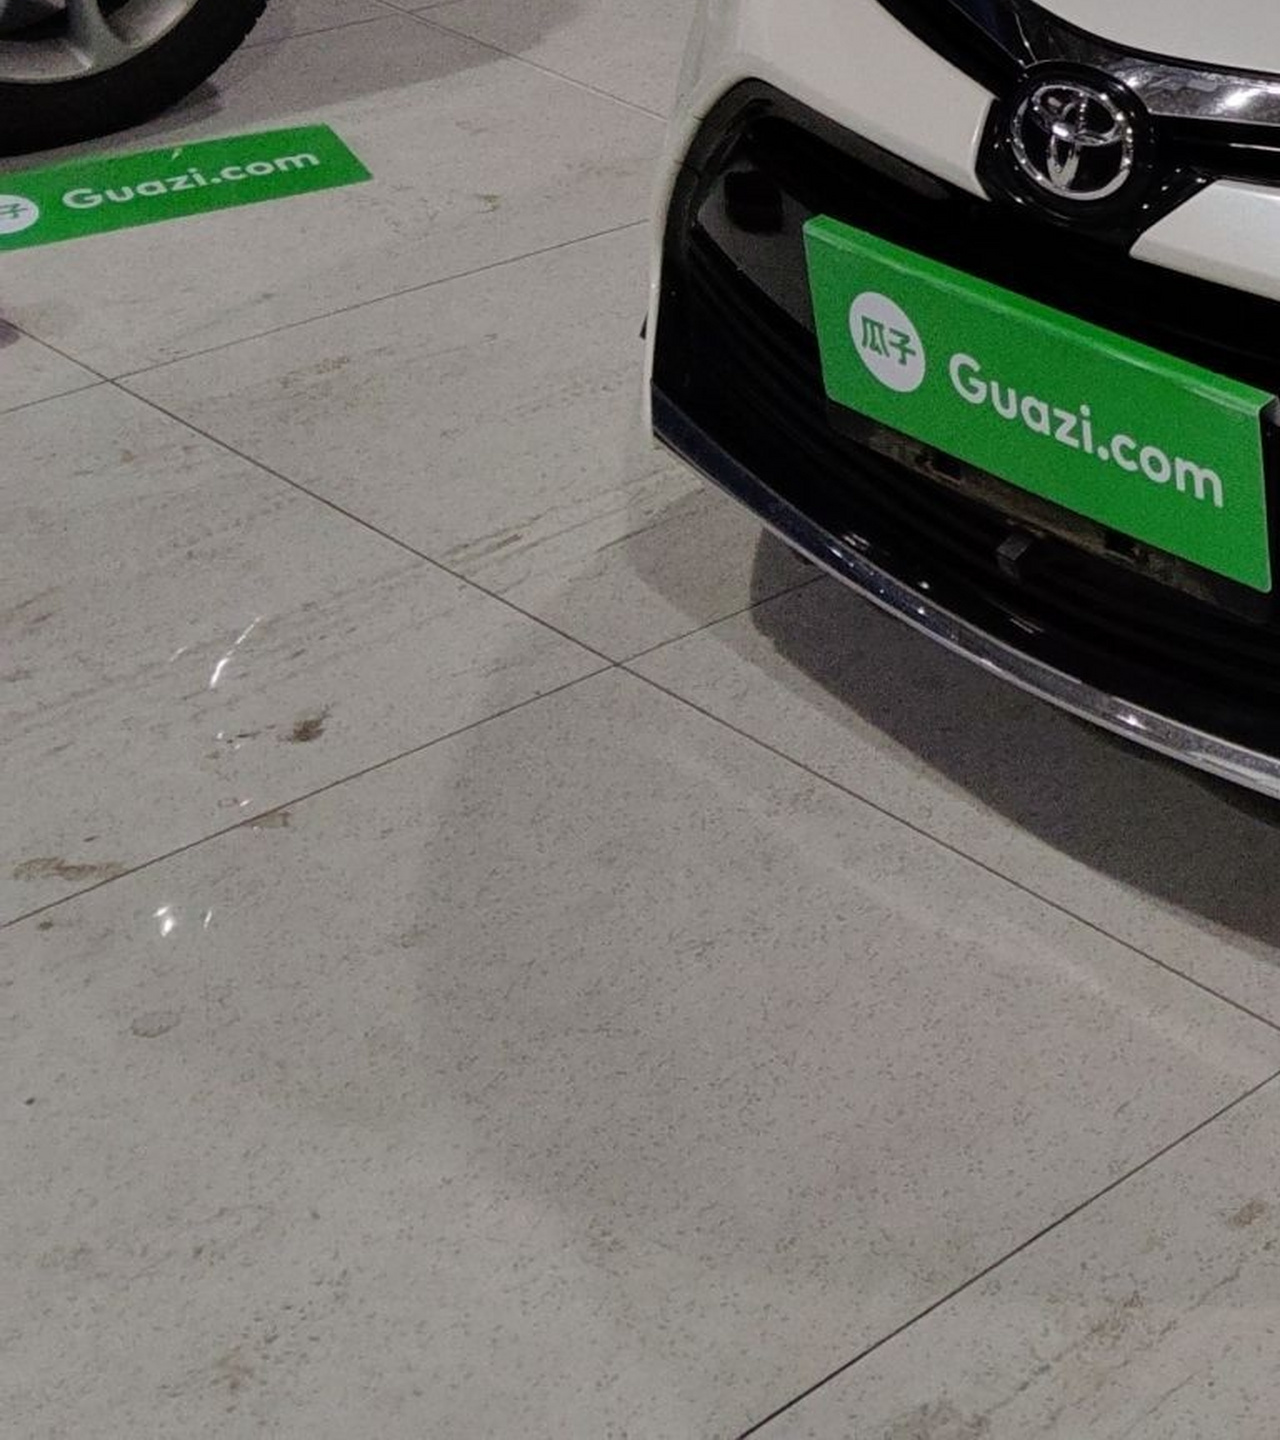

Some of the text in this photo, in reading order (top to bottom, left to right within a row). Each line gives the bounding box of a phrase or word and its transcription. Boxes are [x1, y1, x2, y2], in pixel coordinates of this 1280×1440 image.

[62, 152, 321, 210] Guazi.com
[860, 315, 1224, 509] 瓜子 Guazi.com
